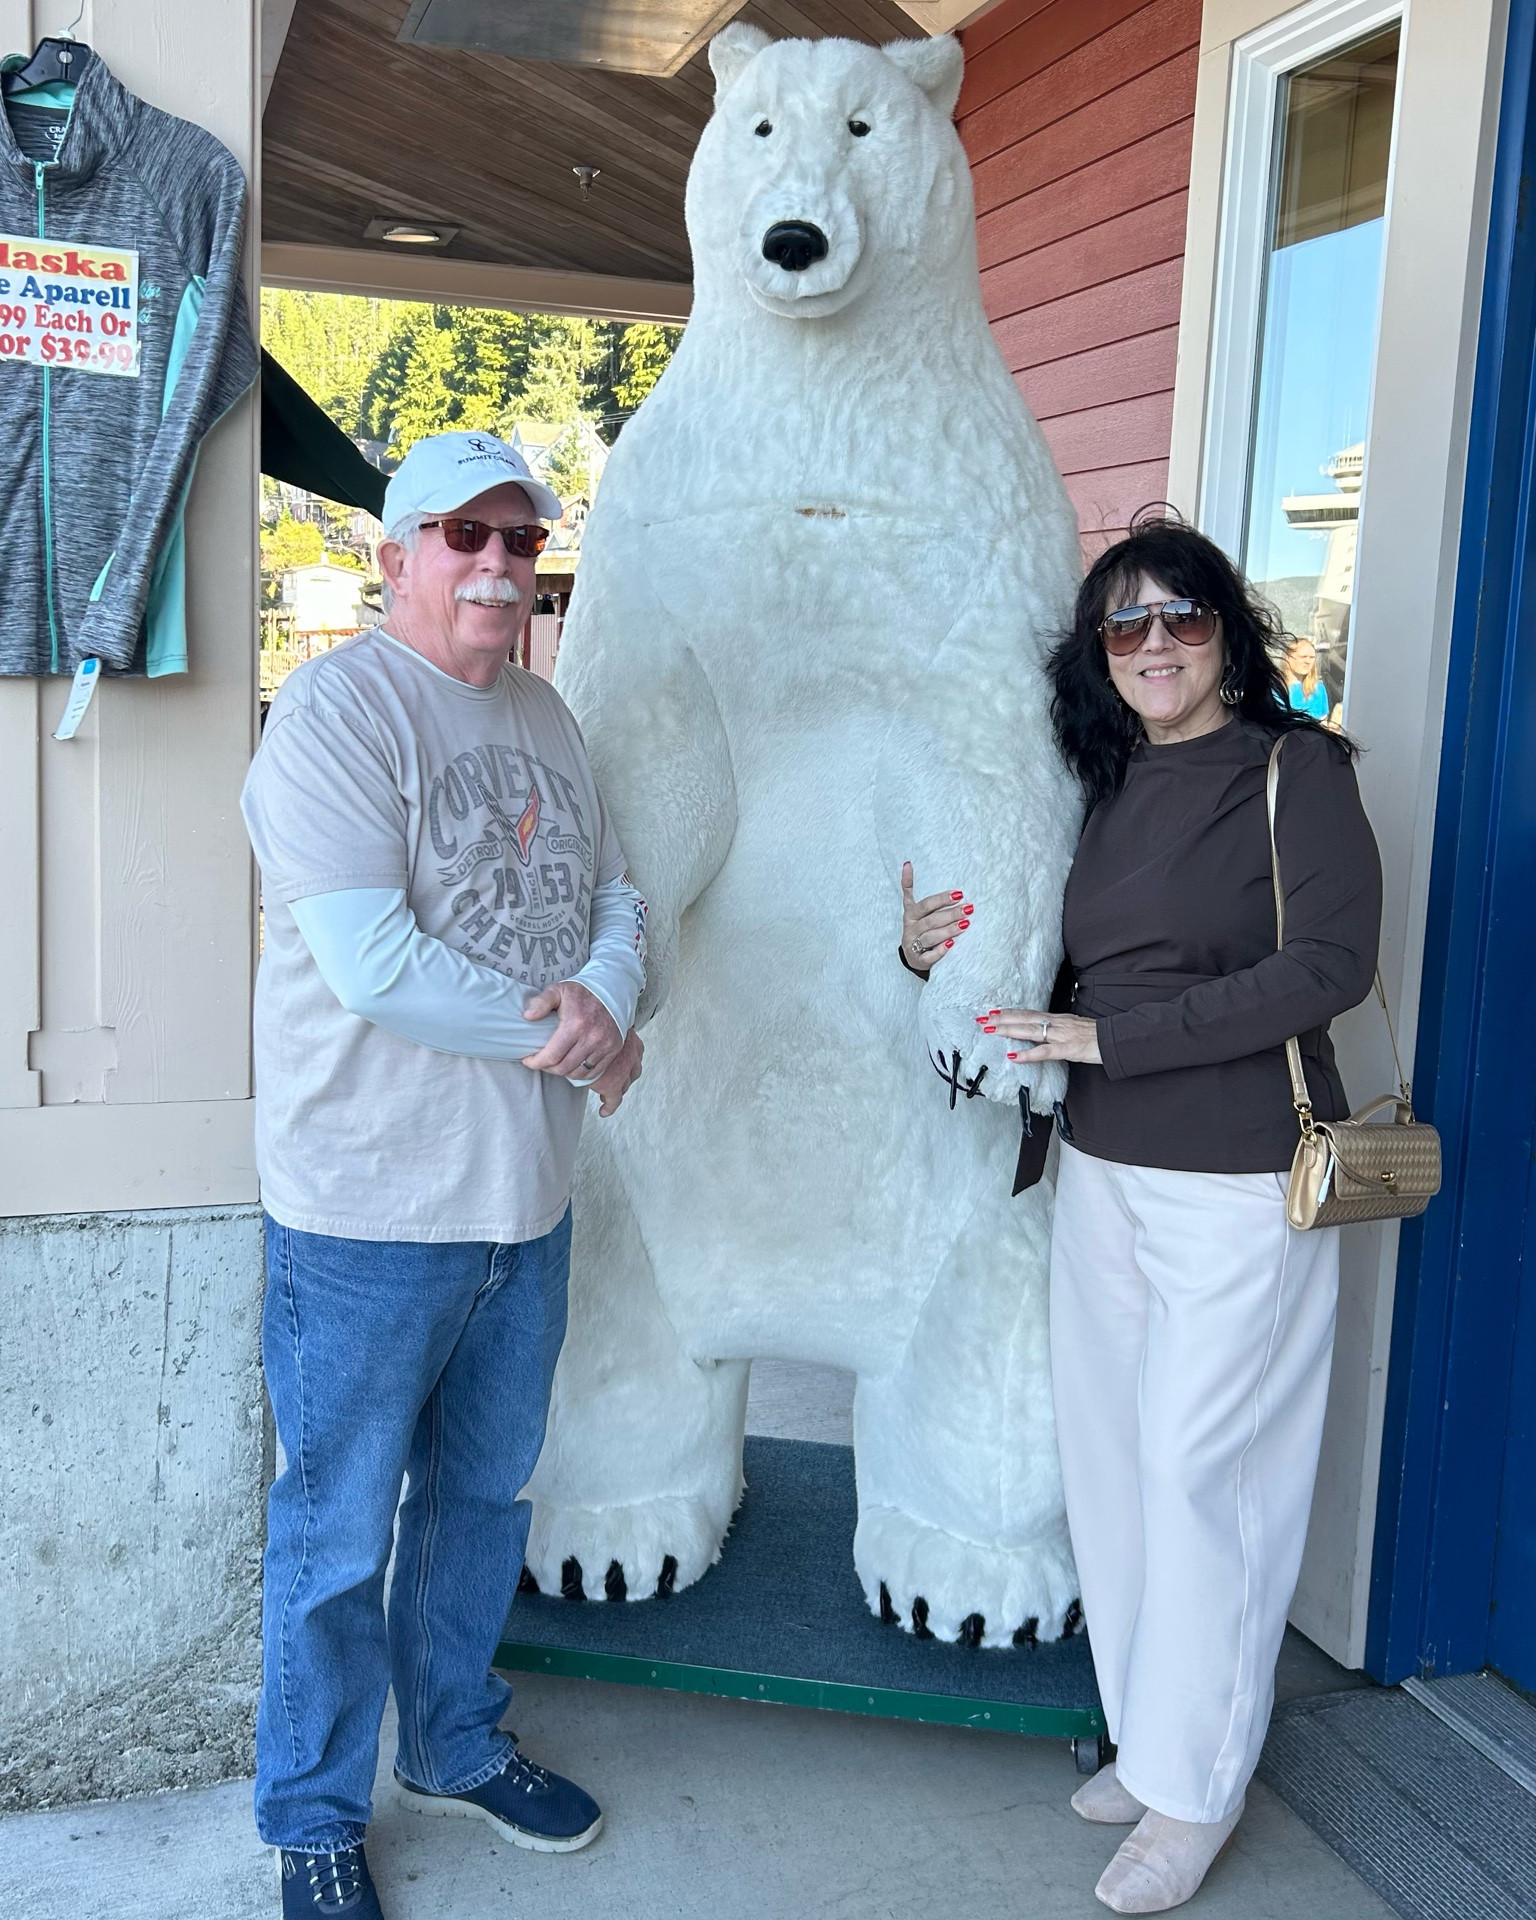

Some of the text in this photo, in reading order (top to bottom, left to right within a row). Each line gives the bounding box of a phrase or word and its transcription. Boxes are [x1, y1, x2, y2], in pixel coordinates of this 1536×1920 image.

[19, 275, 131, 309] Aparell
[34, 304, 93, 333] Each
[101, 312, 131, 337] Or
[40, 332, 133, 372] $39.99
[429, 744, 591, 860] CORVETTE
[456, 842, 500, 877] DETROIT
[526, 871, 541, 910] SINCE
[451, 872, 591, 968] CHEVROLET
[460, 941, 529, 981] MOTOR
